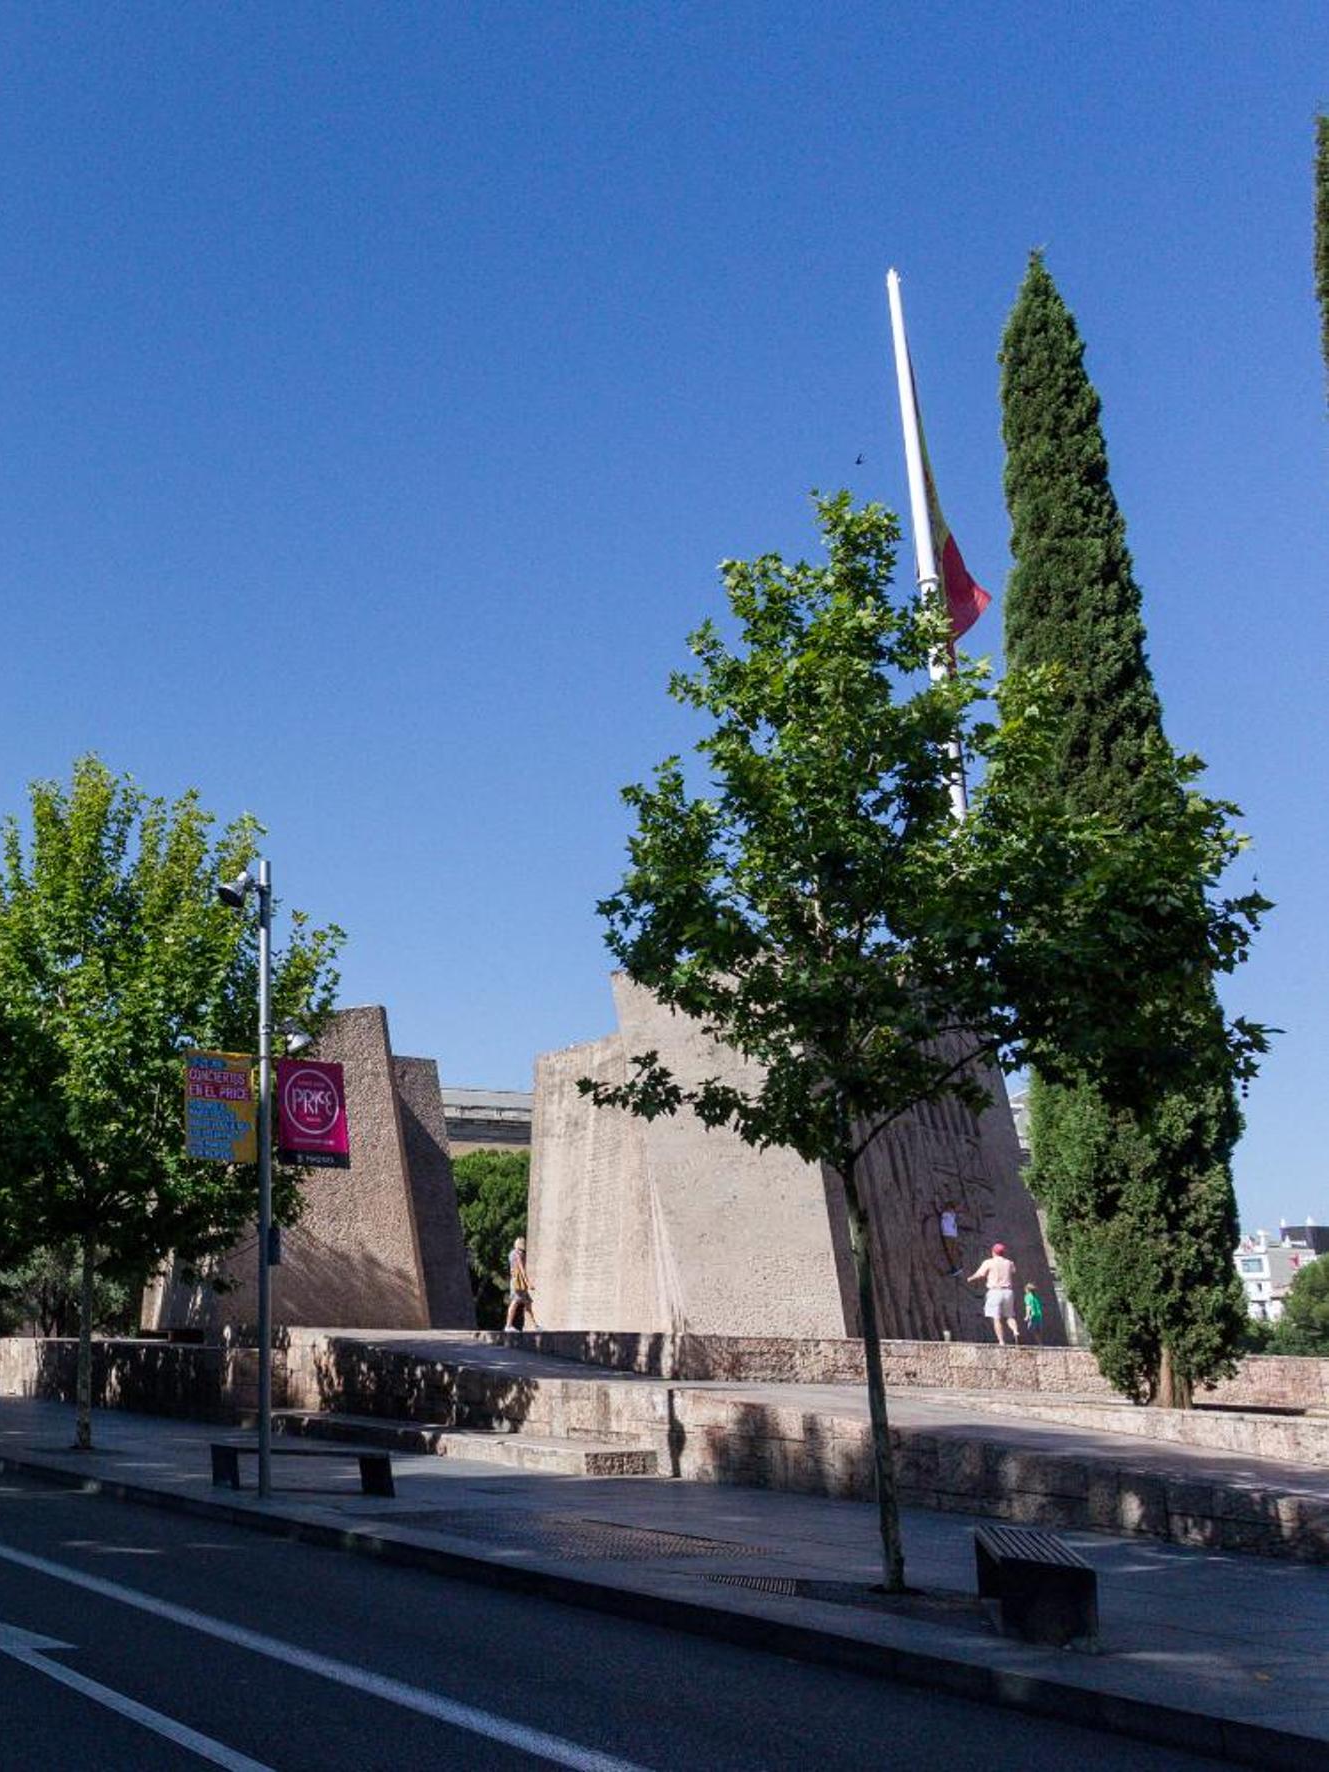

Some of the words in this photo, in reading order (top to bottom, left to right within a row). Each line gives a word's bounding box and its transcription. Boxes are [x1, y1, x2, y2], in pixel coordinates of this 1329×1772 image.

[189, 1084, 203, 1096] EN
[205, 1085, 217, 1098] EL
[292, 1087, 333, 1116] PRICE
